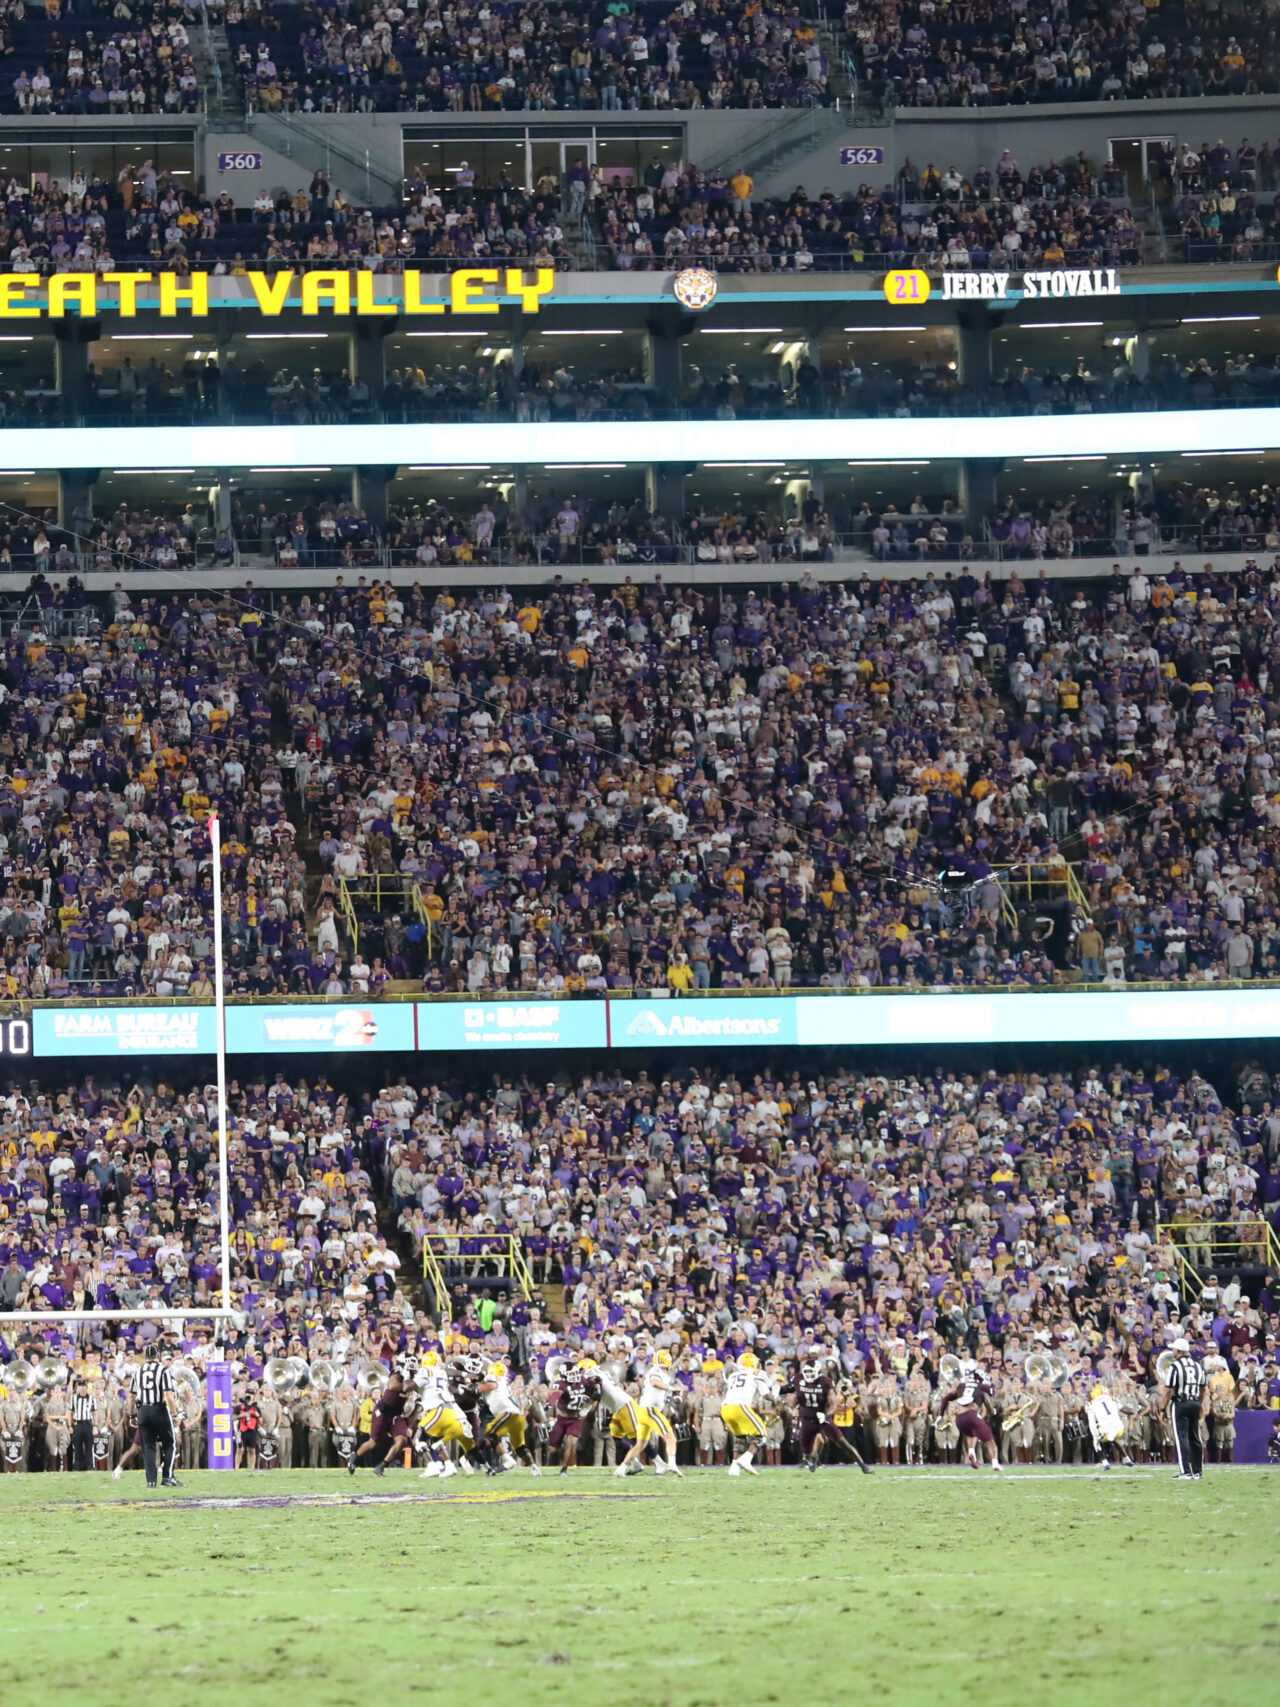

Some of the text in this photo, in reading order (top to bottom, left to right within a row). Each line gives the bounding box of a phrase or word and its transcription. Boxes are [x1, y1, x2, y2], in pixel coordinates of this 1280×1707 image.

[225, 153, 255, 170] 560
[847, 149, 878, 164] 562
[248, 268, 555, 316] VALLEY
[895, 275, 919, 298] 21
[942, 268, 1121, 299] JERRY STOVALL
[55, 1012, 199, 1033] FARM BUREAU
[497, 1007, 559, 1027] BASF
[669, 1015, 781, 1036] Albertsons
[333, 1010, 364, 1046] 2
[804, 1393, 818, 1407] 11
[1102, 1401, 1112, 1415] 1
[213, 1390, 232, 1457] LSU
